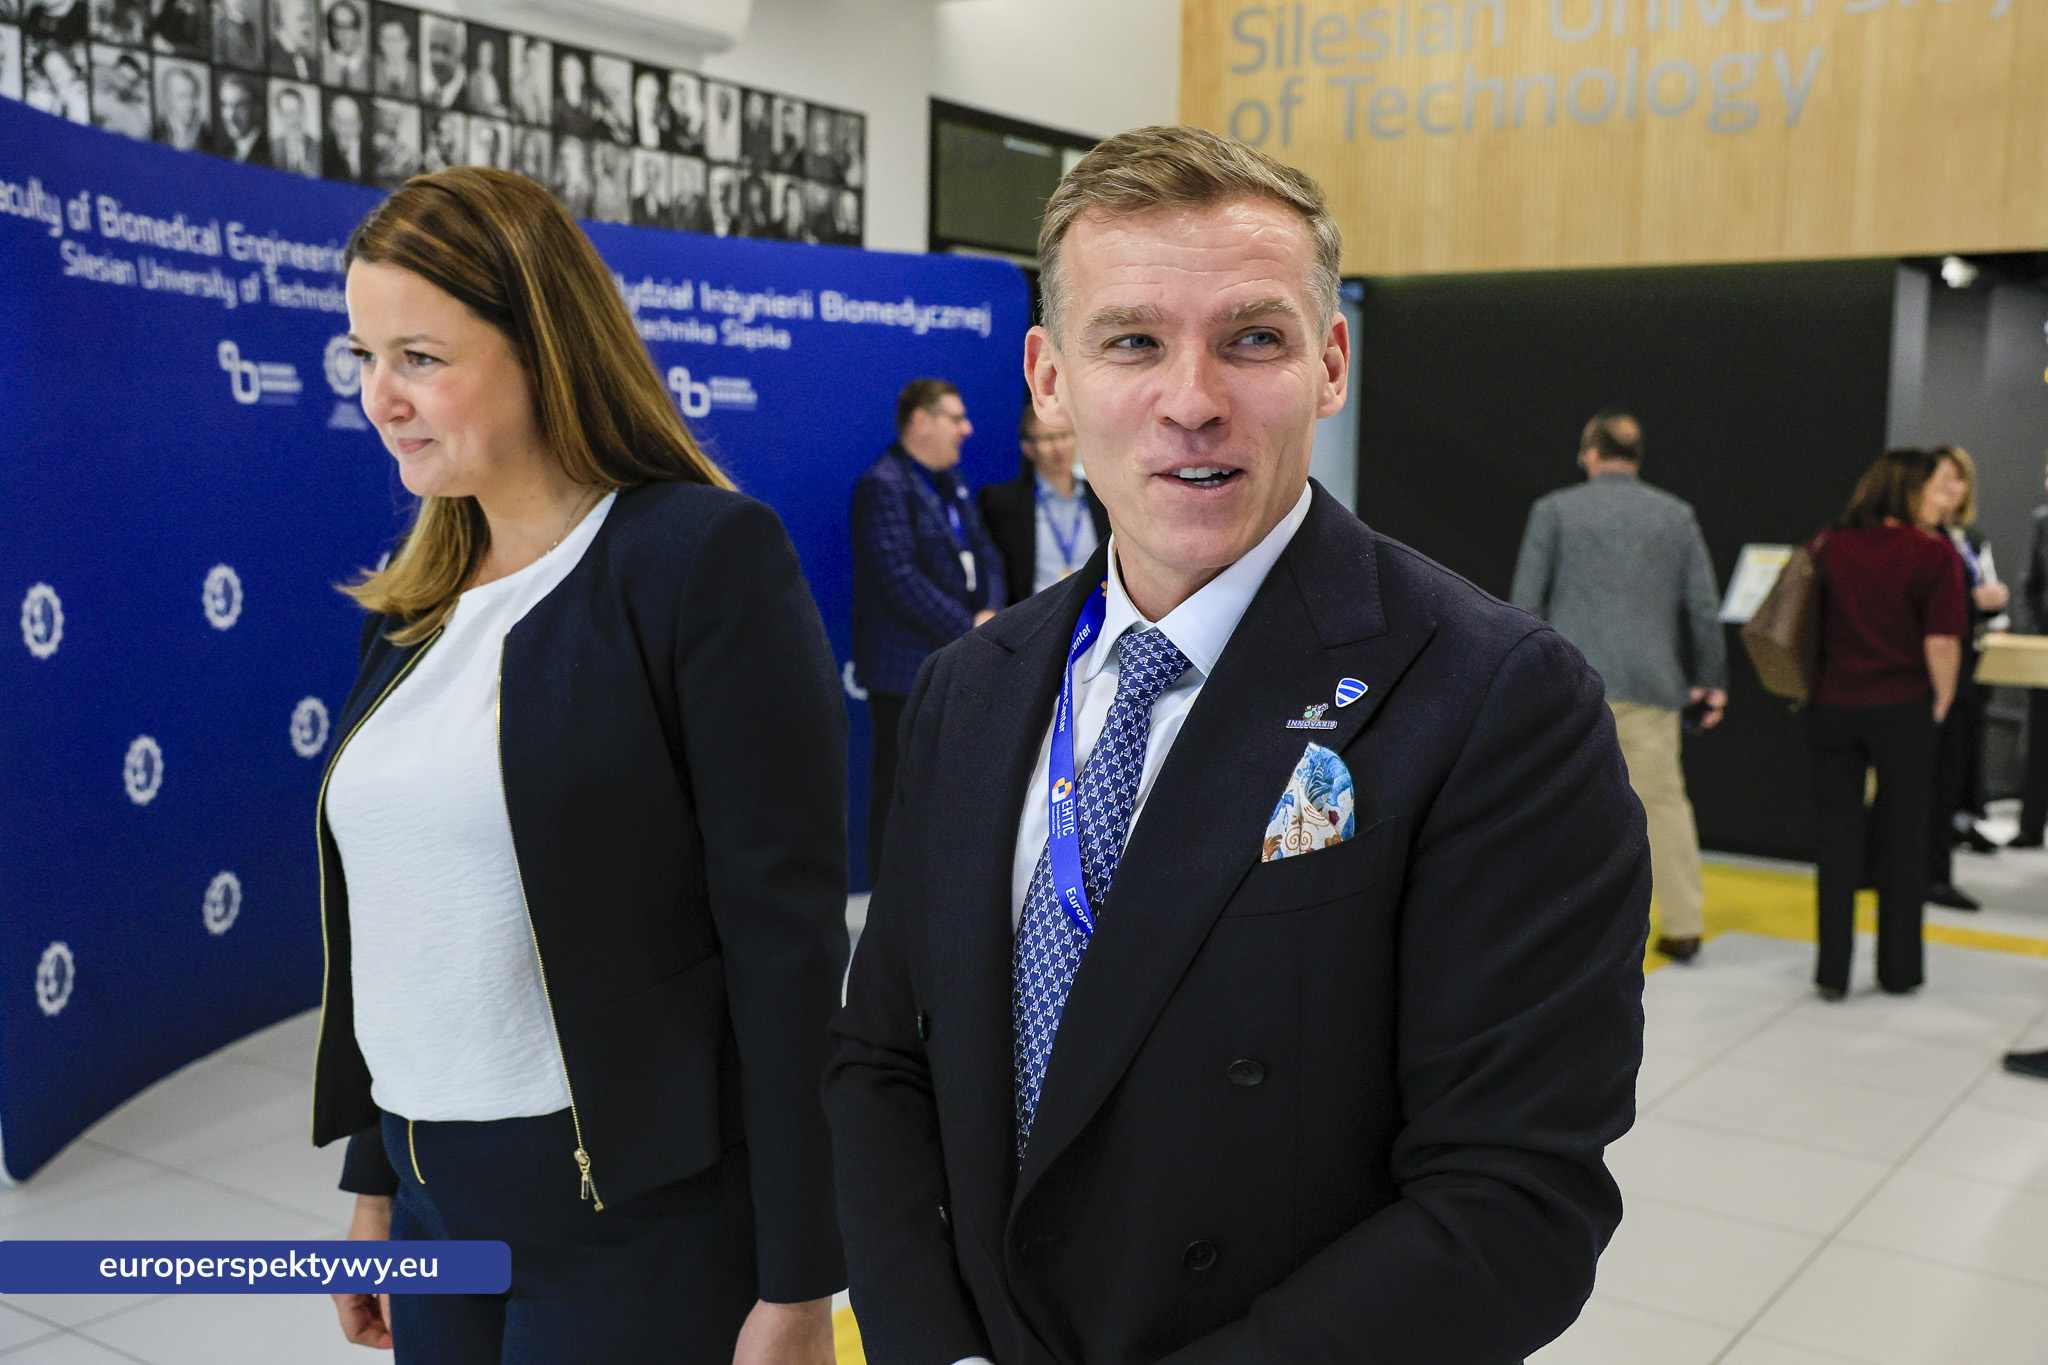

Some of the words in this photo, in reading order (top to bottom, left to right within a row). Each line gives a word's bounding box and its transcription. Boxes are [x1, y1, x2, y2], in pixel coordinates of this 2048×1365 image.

[1230, 0, 1505, 74] Silesian
[1228, 76, 1303, 148] of
[1326, 44, 1824, 143] Technology
[67, 190, 91, 232] of
[96, 195, 222, 258] Biomedical
[60, 239, 137, 288] Silesian
[137, 256, 238, 309] University
[239, 273, 260, 303] of
[820, 290, 992, 338] Biomedycznej
[1062, 798, 1075, 836] EHTIC
